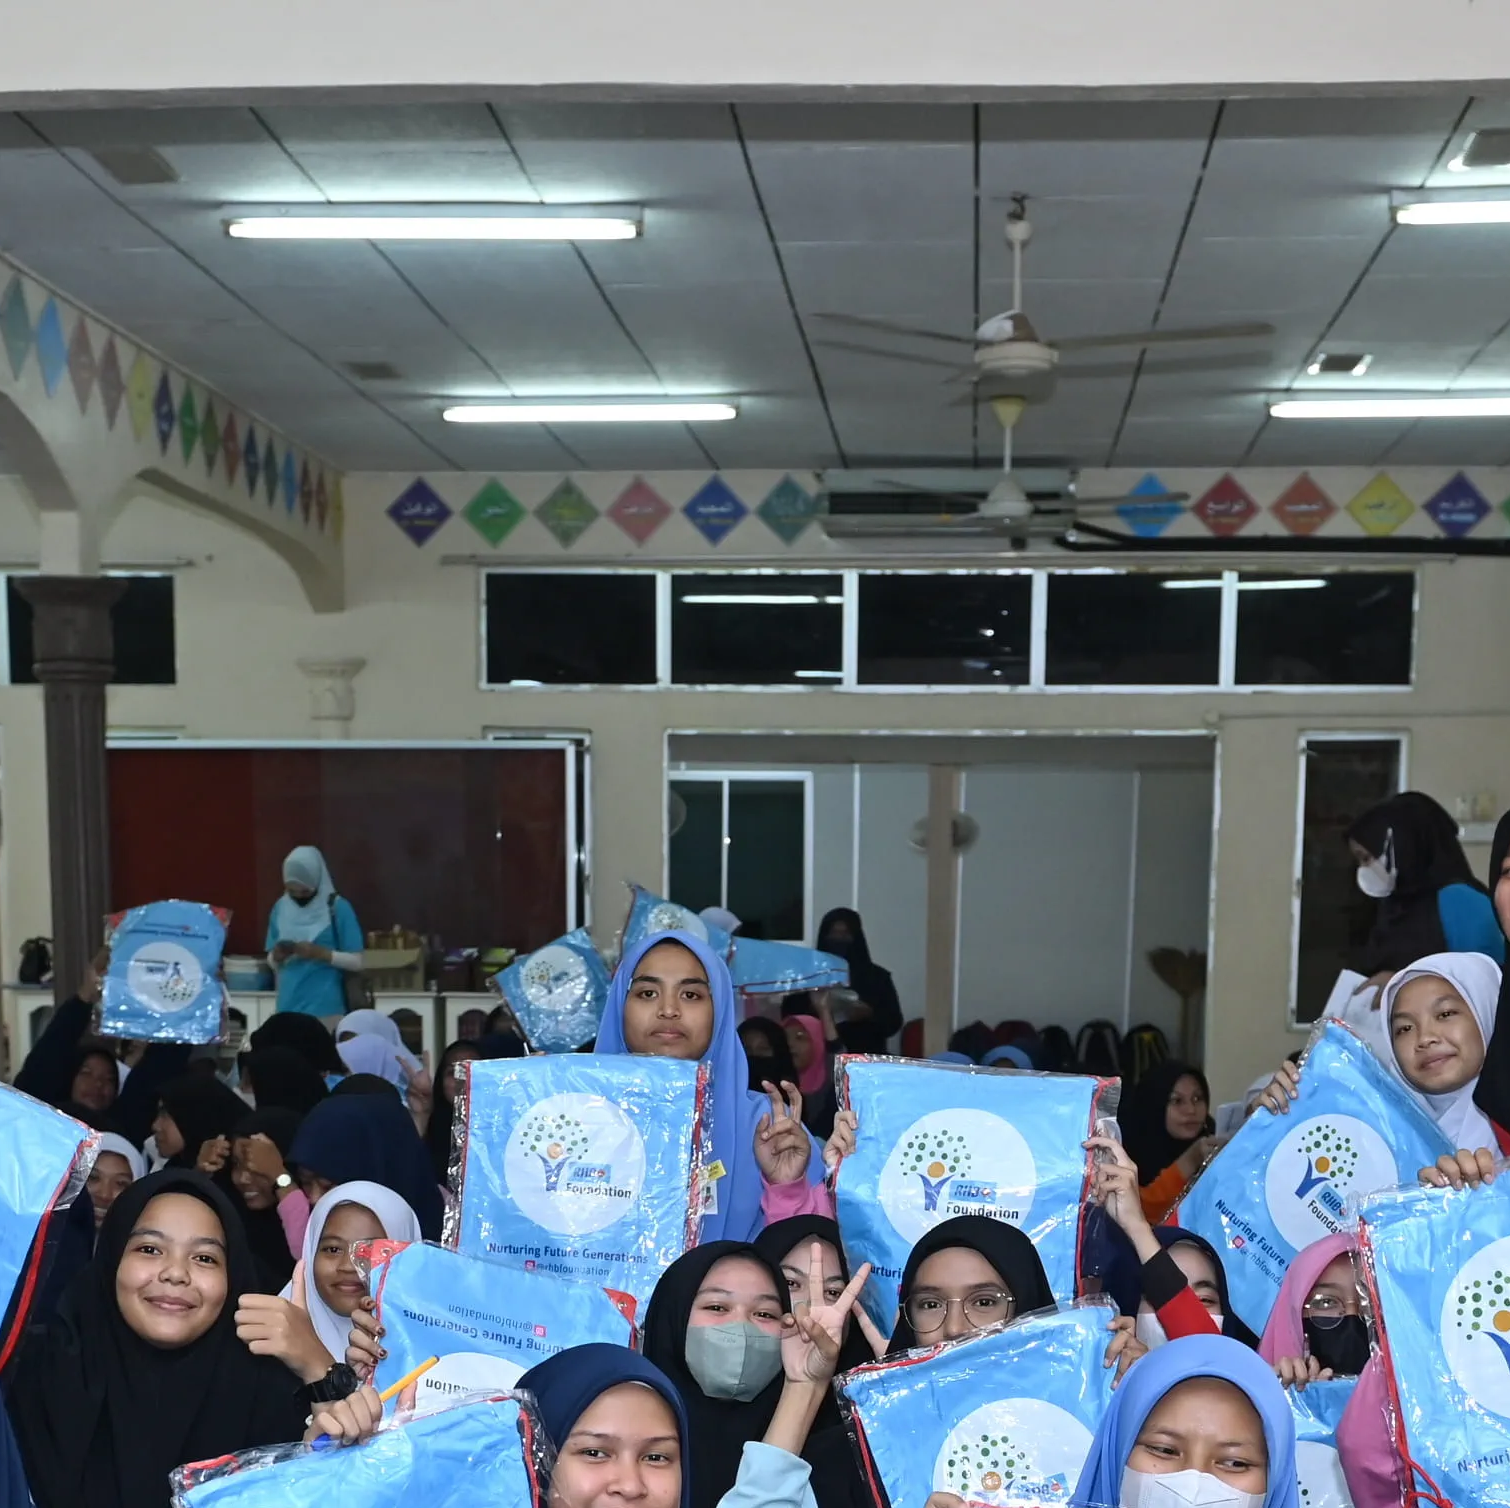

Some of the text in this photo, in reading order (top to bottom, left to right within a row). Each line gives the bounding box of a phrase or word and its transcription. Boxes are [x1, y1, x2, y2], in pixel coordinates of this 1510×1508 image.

[1320, 1191, 1341, 1211] RHB
[1215, 1200, 1286, 1267] Nurturing Future
[489, 1243, 649, 1265] Nurturing Future Generations
[402, 1308, 478, 1339] Generations
[482, 1330, 522, 1350] Future
